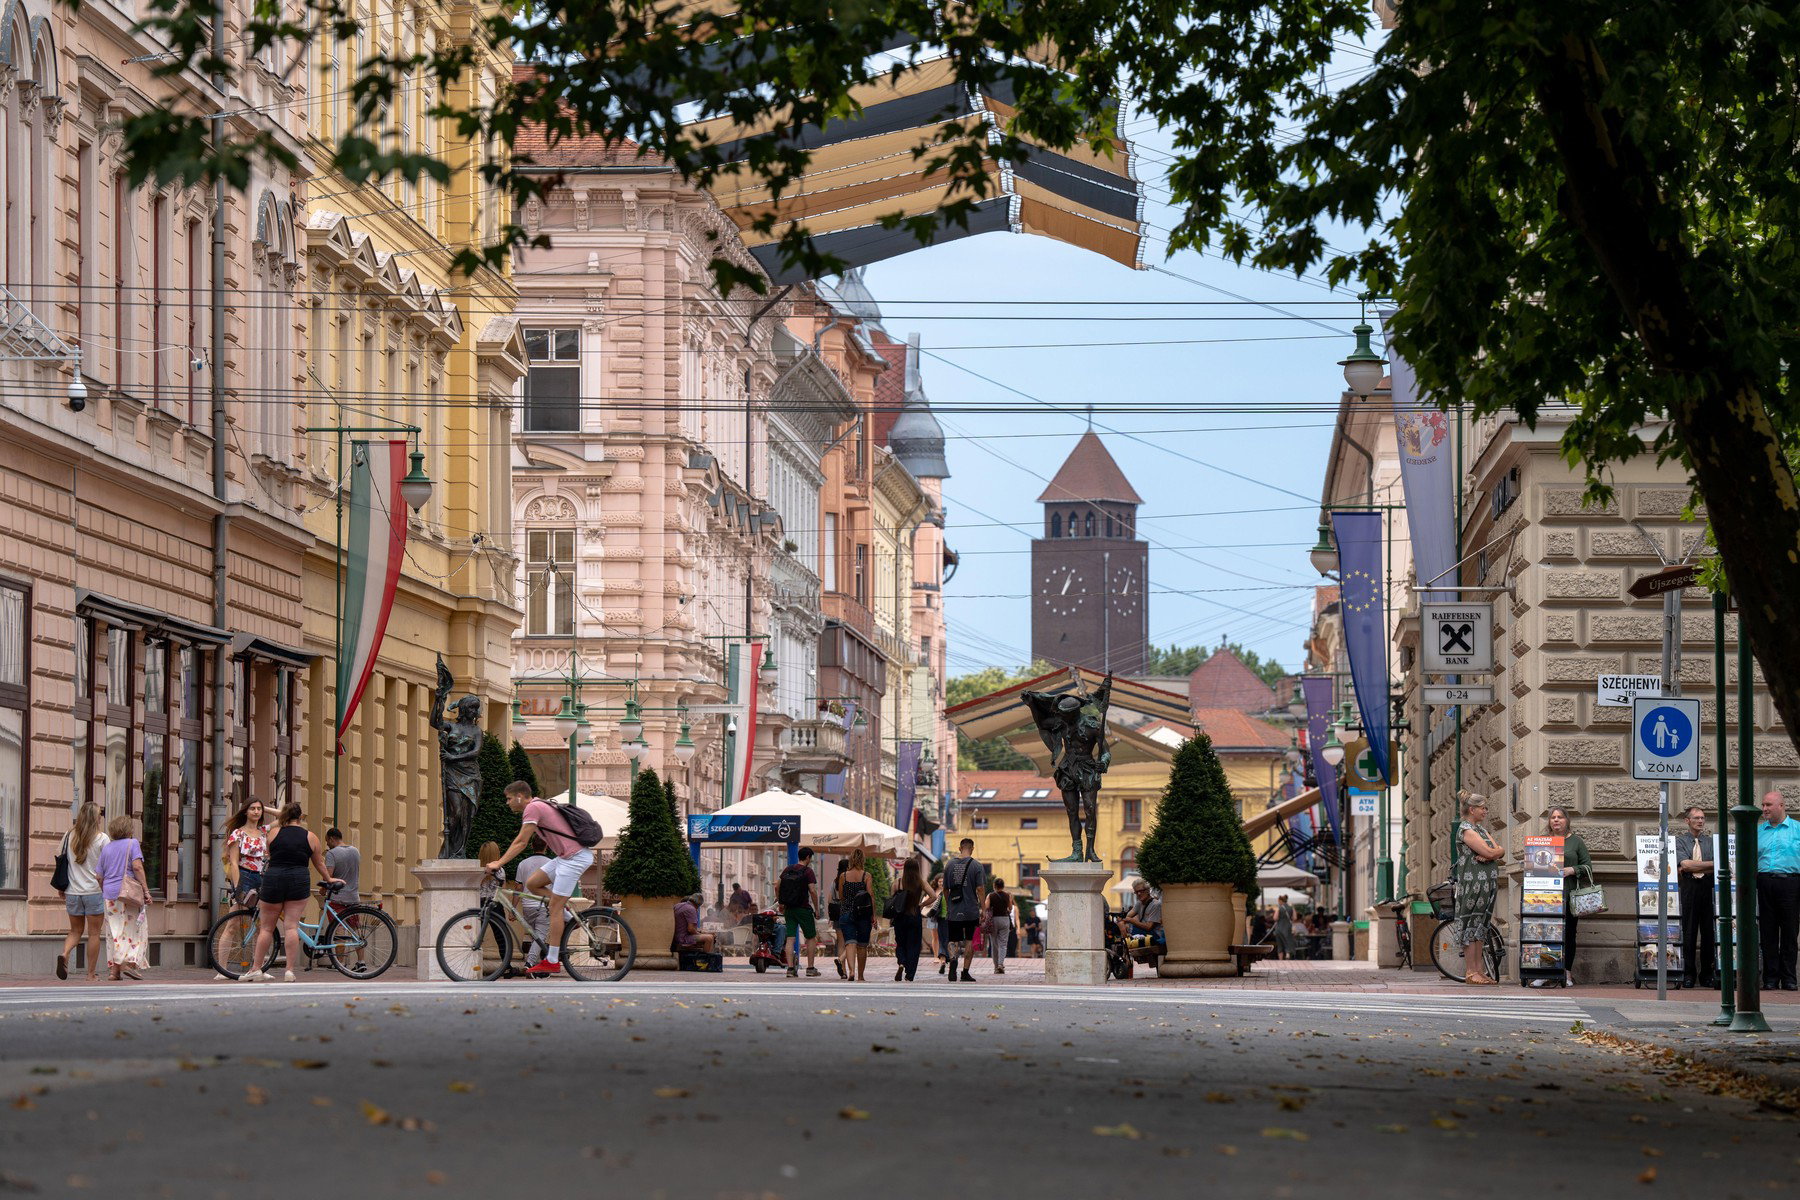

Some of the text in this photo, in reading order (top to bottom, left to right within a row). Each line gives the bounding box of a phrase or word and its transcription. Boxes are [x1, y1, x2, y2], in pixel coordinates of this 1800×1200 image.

[1431, 612, 1482, 620] RAIFFEISEN
[1445, 657, 1470, 665] BANK
[1602, 676, 1660, 690] SZÉCHENYI
[1446, 690, 1469, 700] 0-24
[1647, 761, 1684, 773] ZÓNA
[710, 825, 737, 833] SZEGEDI
[758, 825, 773, 833] ZRT.
